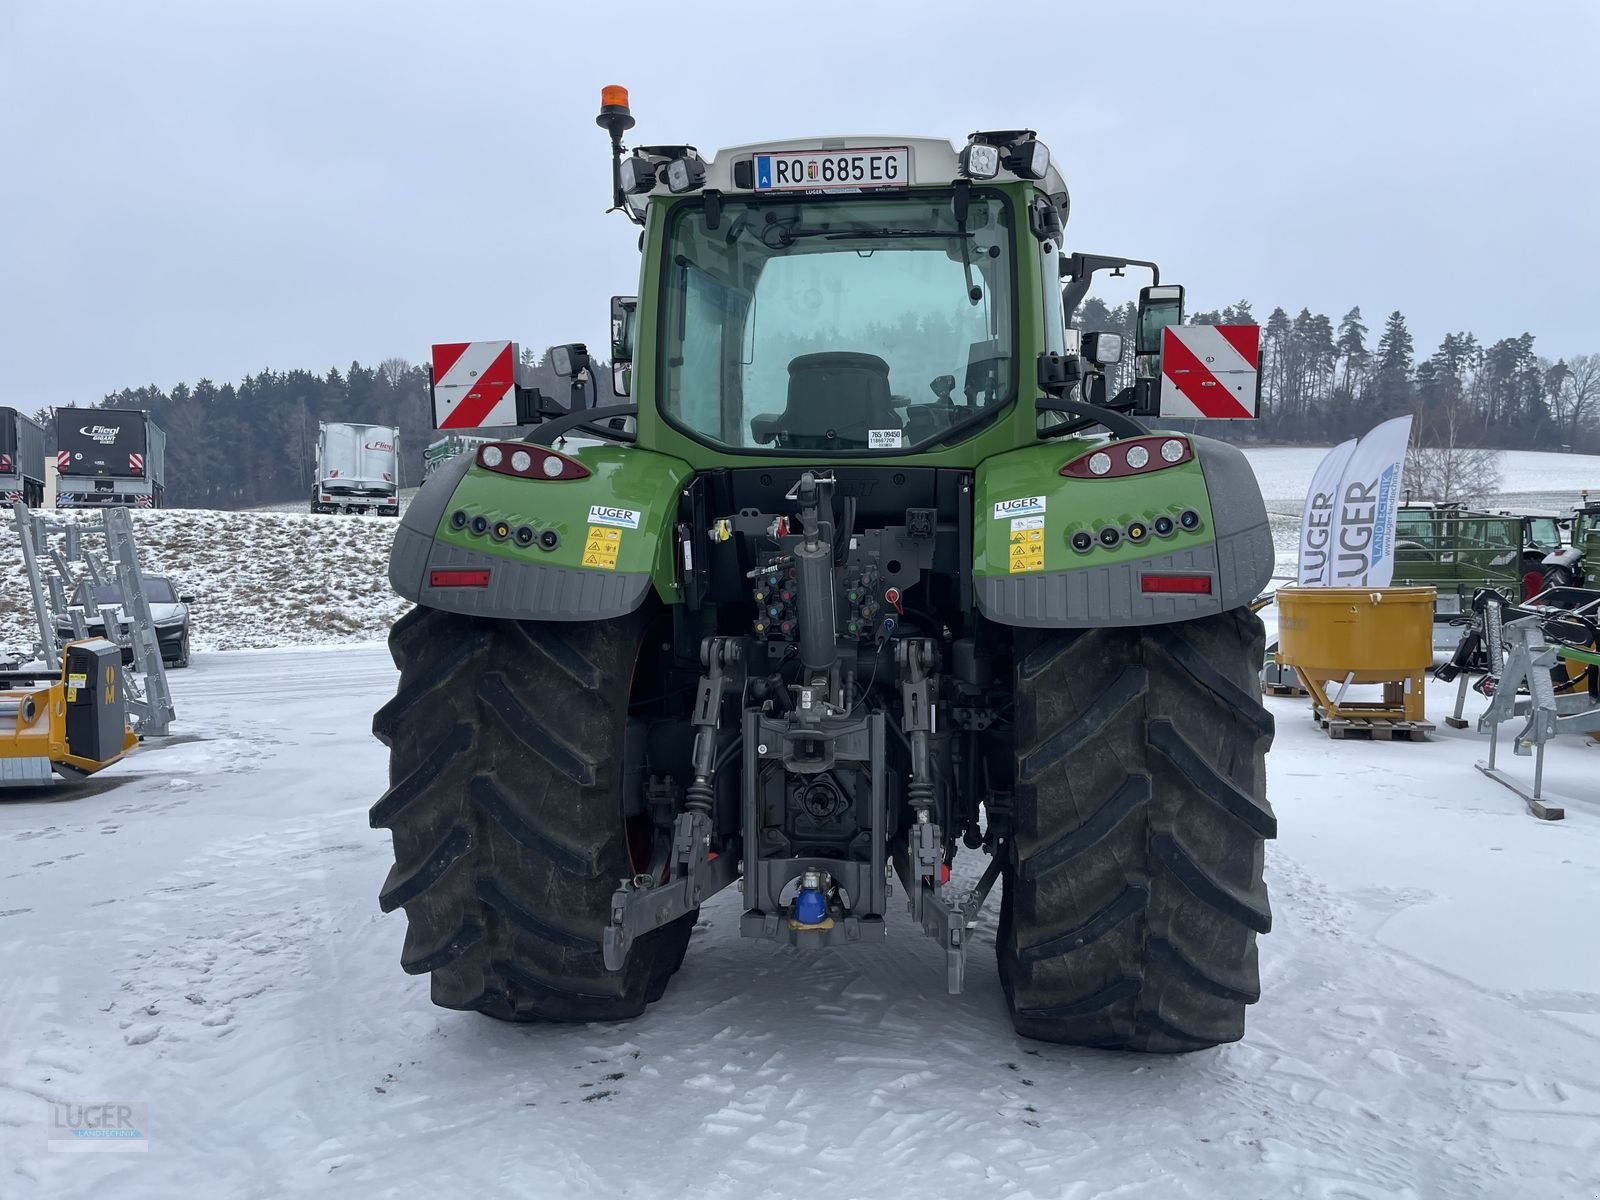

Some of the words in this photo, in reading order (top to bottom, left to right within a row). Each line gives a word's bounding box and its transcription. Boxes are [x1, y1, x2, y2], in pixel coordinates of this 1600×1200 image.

[761, 176, 768, 184] A
[776, 159, 804, 184] RO
[822, 157, 864, 182] 685
[870, 155, 898, 180] EG
[92, 425, 120, 436] Fliegl
[996, 498, 1038, 512] LUGER
[591, 507, 633, 520] LUGER
[1373, 474, 1393, 558] LANDTECHNIK
